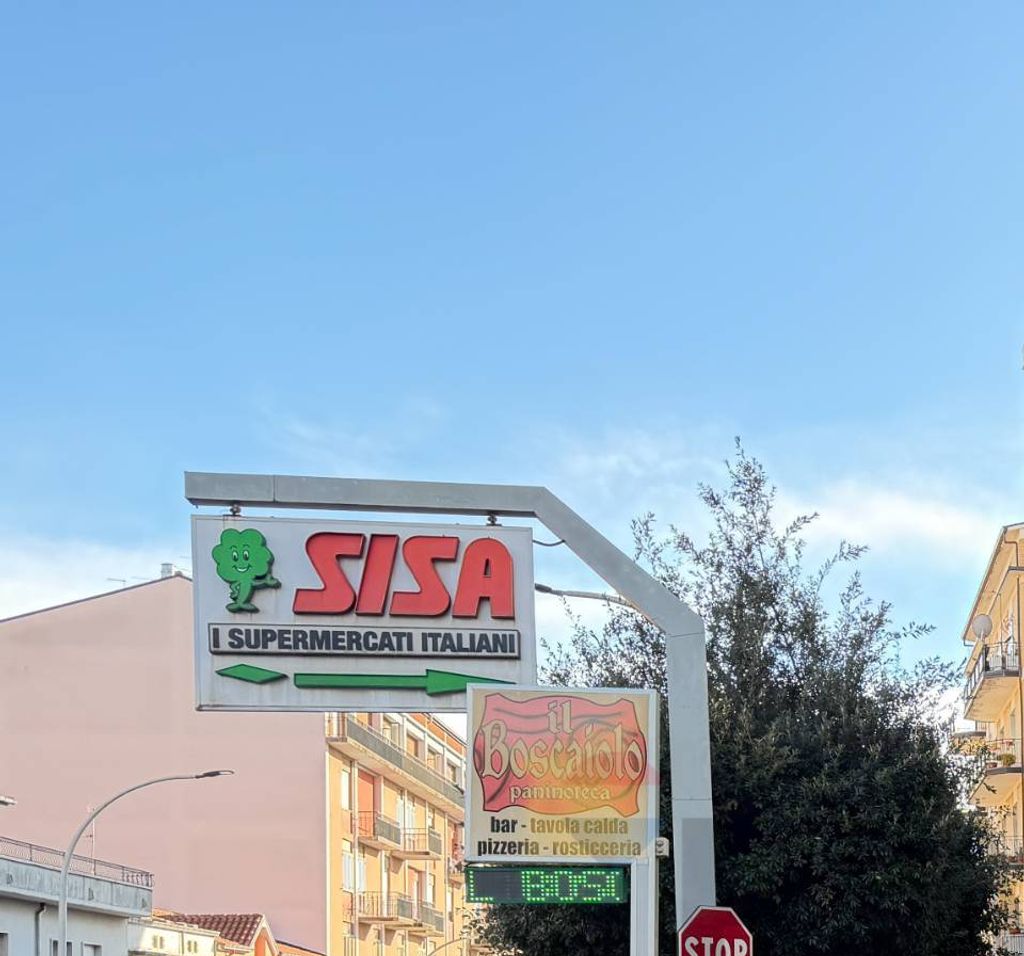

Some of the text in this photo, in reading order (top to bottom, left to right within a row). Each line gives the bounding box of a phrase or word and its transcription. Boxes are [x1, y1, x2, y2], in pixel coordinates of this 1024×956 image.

[292, 531, 516, 620] SISA
[212, 627, 516, 654] I SUPERMERCATI ITALIANI
[547, 700, 574, 735] il
[482, 719, 645, 781] Boscaiolo
[510, 784, 611, 803] paninoteca
[491, 816, 518, 834] bar
[530, 817, 580, 834] tavola
[583, 817, 628, 834] calda
[477, 839, 540, 856] pizzeria
[552, 839, 642, 856] rosticceria
